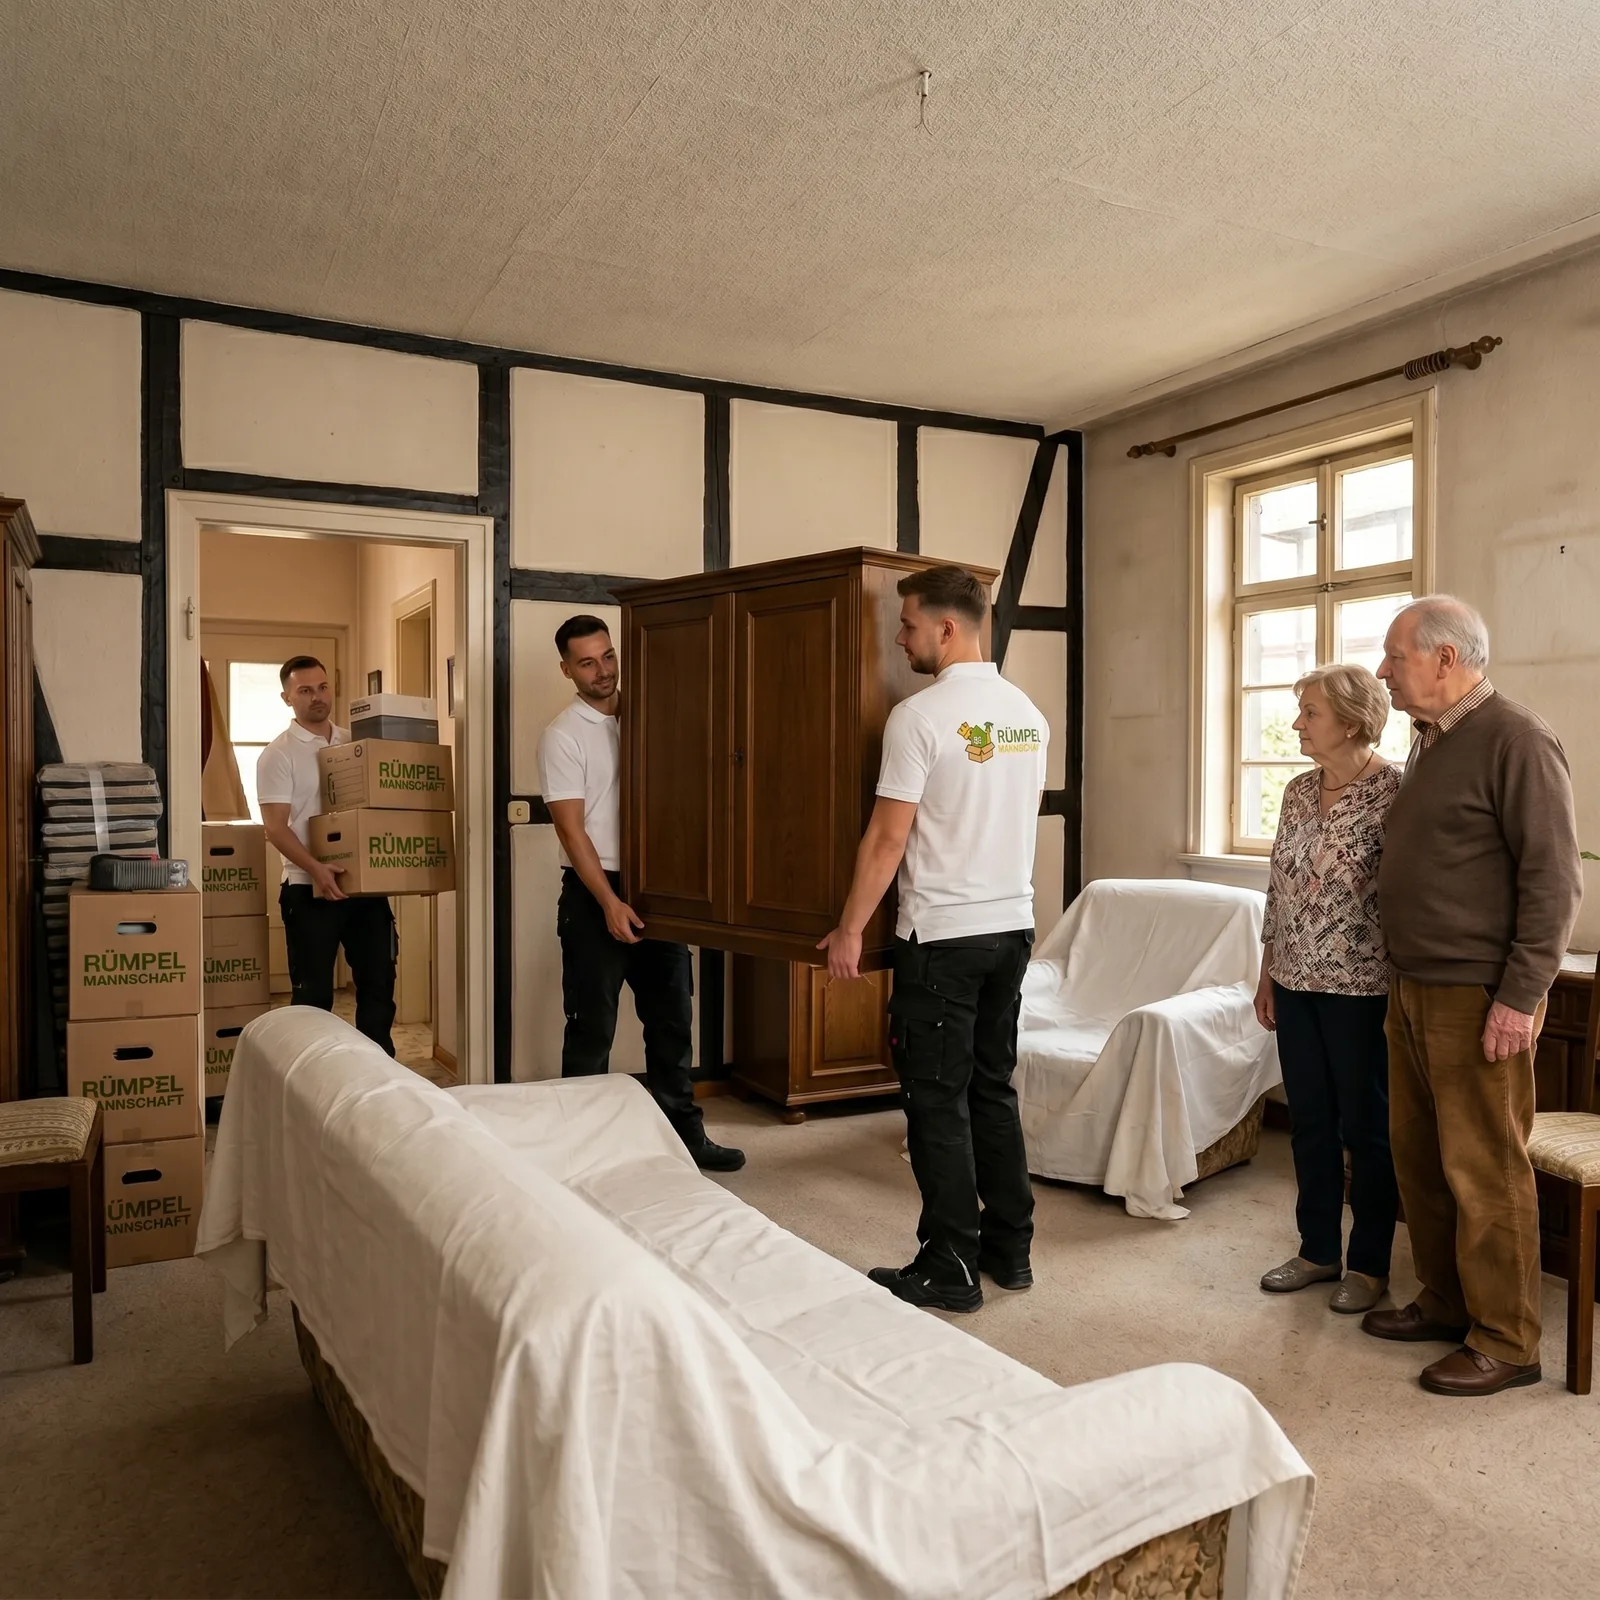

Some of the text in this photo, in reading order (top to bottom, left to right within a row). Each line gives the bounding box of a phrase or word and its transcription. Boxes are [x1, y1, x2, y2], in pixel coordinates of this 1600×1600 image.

[997, 727, 1041, 744] RÜMPEL
[379, 759, 446, 781] RÜMPEL
[379, 780, 446, 792] MANNSCHAFT
[369, 832, 447, 855] RÜMPEL
[369, 856, 448, 868] MANNSCHAFT
[202, 865, 259, 882] ÜMPEL
[202, 882, 259, 892] NNSCHAFT
[84, 949, 186, 973] RÜMPEL
[203, 957, 262, 974] ÜMPEL
[83, 972, 186, 987] MANNSCHAFT
[203, 972, 262, 984] ANNSCHAFT
[82, 1075, 184, 1098] RÜMPEL
[97, 1094, 185, 1112] ANNSCHAFT
[107, 1195, 192, 1221] ÜMPEL
[105, 1214, 192, 1235] ANNSCHAFT
